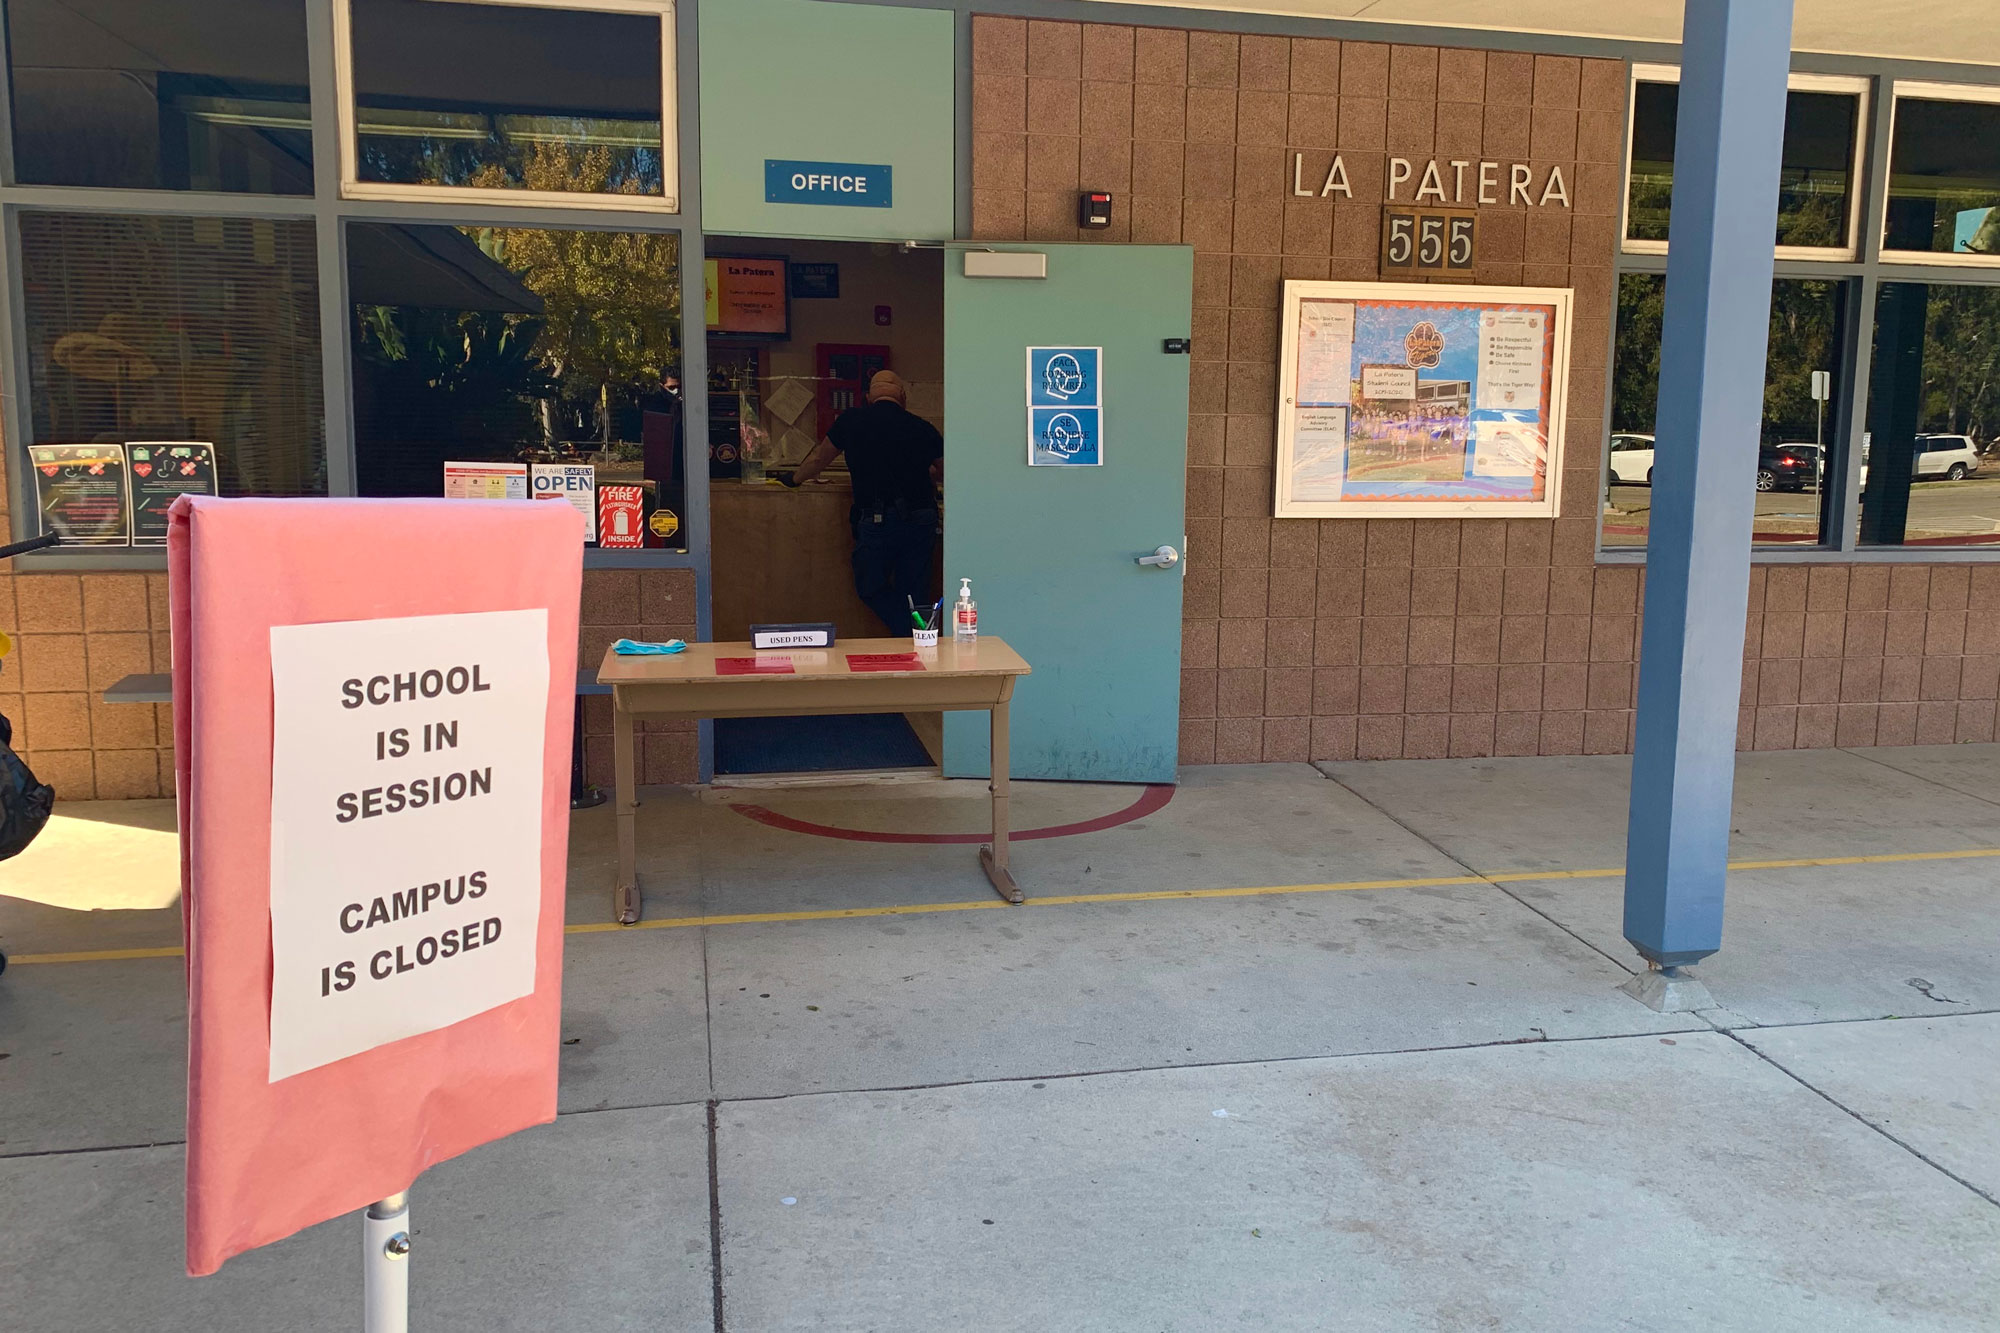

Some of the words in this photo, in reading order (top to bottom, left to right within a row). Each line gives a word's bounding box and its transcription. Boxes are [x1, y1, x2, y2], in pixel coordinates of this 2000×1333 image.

[791, 173, 867, 193] OFFICE
[1294, 153, 1353, 198] LA
[1389, 157, 1570, 207] PATERA
[1389, 219, 1473, 264] 555
[728, 266, 740, 275] La
[743, 267, 775, 276] Patera
[1053, 358, 1076, 367] FACE
[1060, 418, 1072, 427] SE
[534, 467, 547, 475] WE
[534, 475, 594, 491] OPEN
[608, 491, 634, 501] FIRE
[607, 535, 636, 543] INSIDE
[770, 636, 791, 644] USED
[792, 635, 814, 643] PENS
[914, 632, 936, 640] CLEAN
[341, 664, 491, 709] SCHOOL
[376, 728, 410, 761] IS
[423, 720, 459, 753] IN
[335, 767, 492, 823] SESSION
[339, 870, 488, 934] CAMPUS
[321, 960, 356, 997] IS
[369, 916, 502, 980] CLOSED
